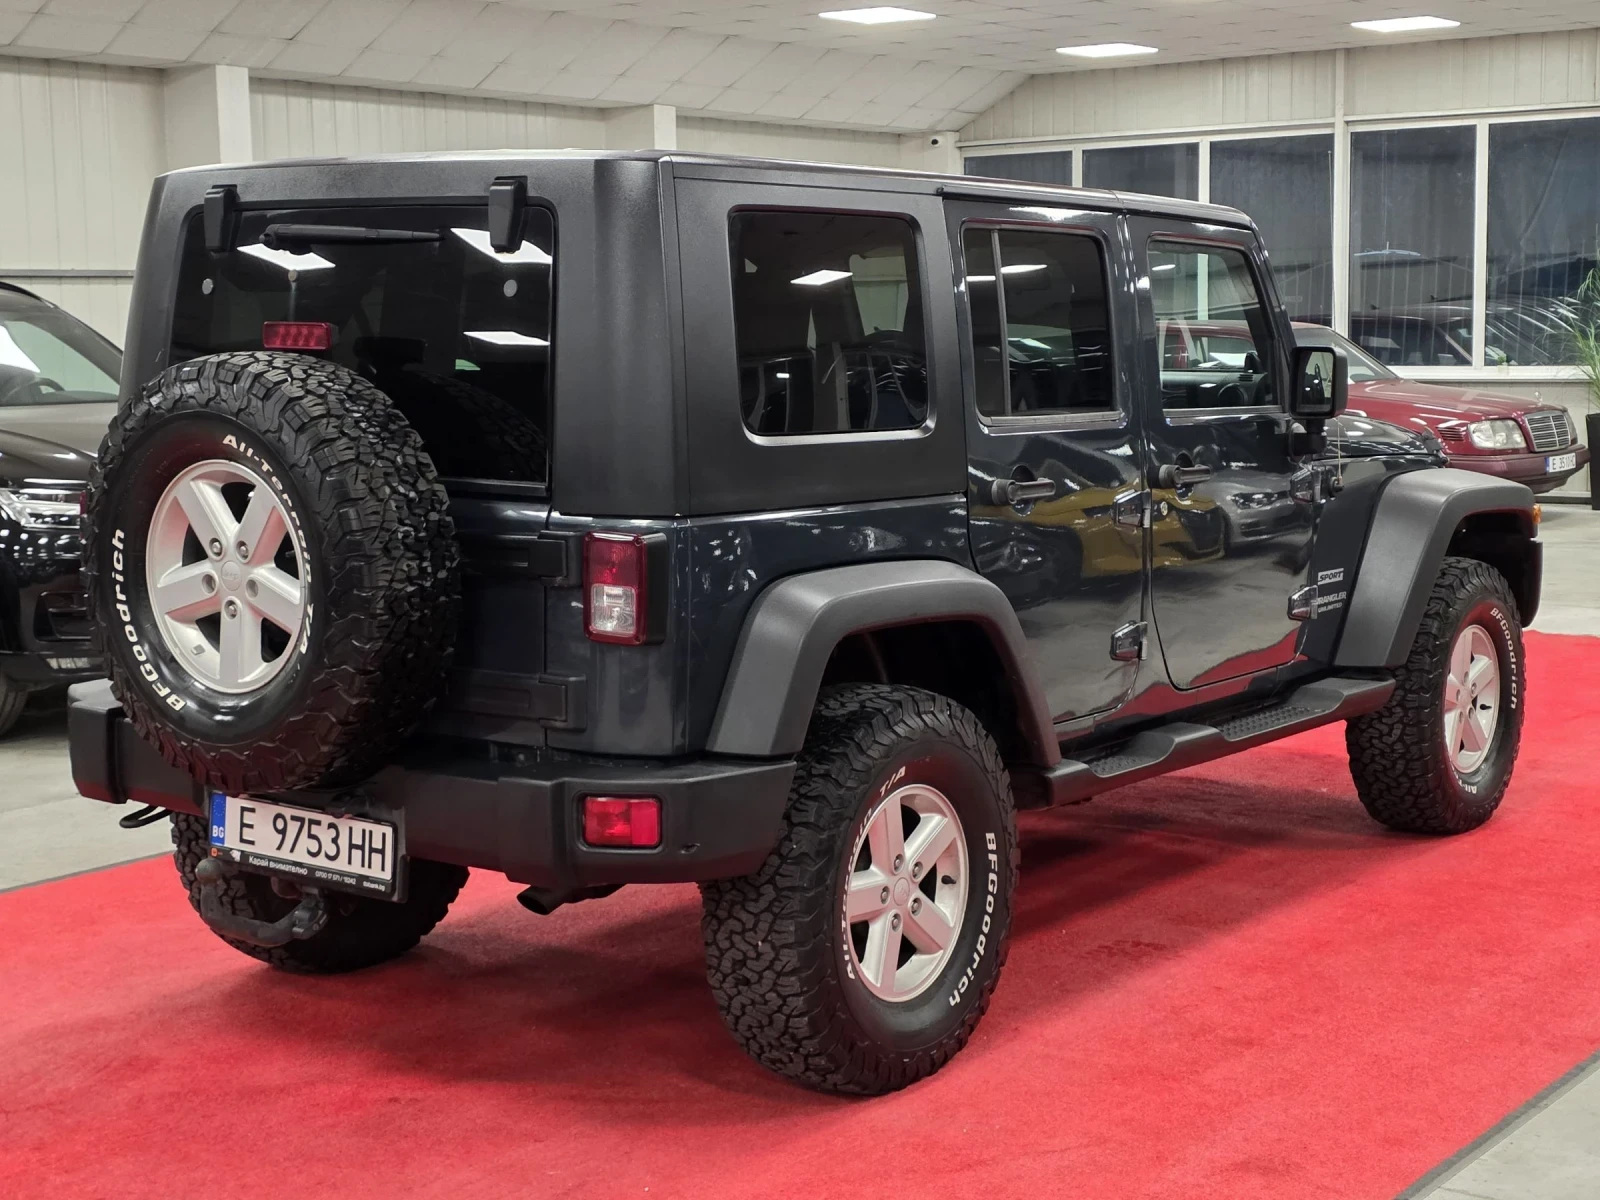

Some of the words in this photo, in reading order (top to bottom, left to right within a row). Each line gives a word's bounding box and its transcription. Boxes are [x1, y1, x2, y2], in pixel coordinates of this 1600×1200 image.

[222, 434, 312, 583] All-Terrain
[1319, 571, 1342, 582] SPORT
[1317, 591, 1347, 606] RANGLER
[111, 529, 187, 712] BFGoodrich
[1490, 607, 1518, 710] BFGoodrich
[879, 766, 906, 798] T/A
[212, 824, 225, 839] BG
[239, 806, 256, 846] E
[249, 855, 269, 867] Карай
[269, 861, 308, 875] внимателно
[949, 832, 998, 1007] BFGoodrich
